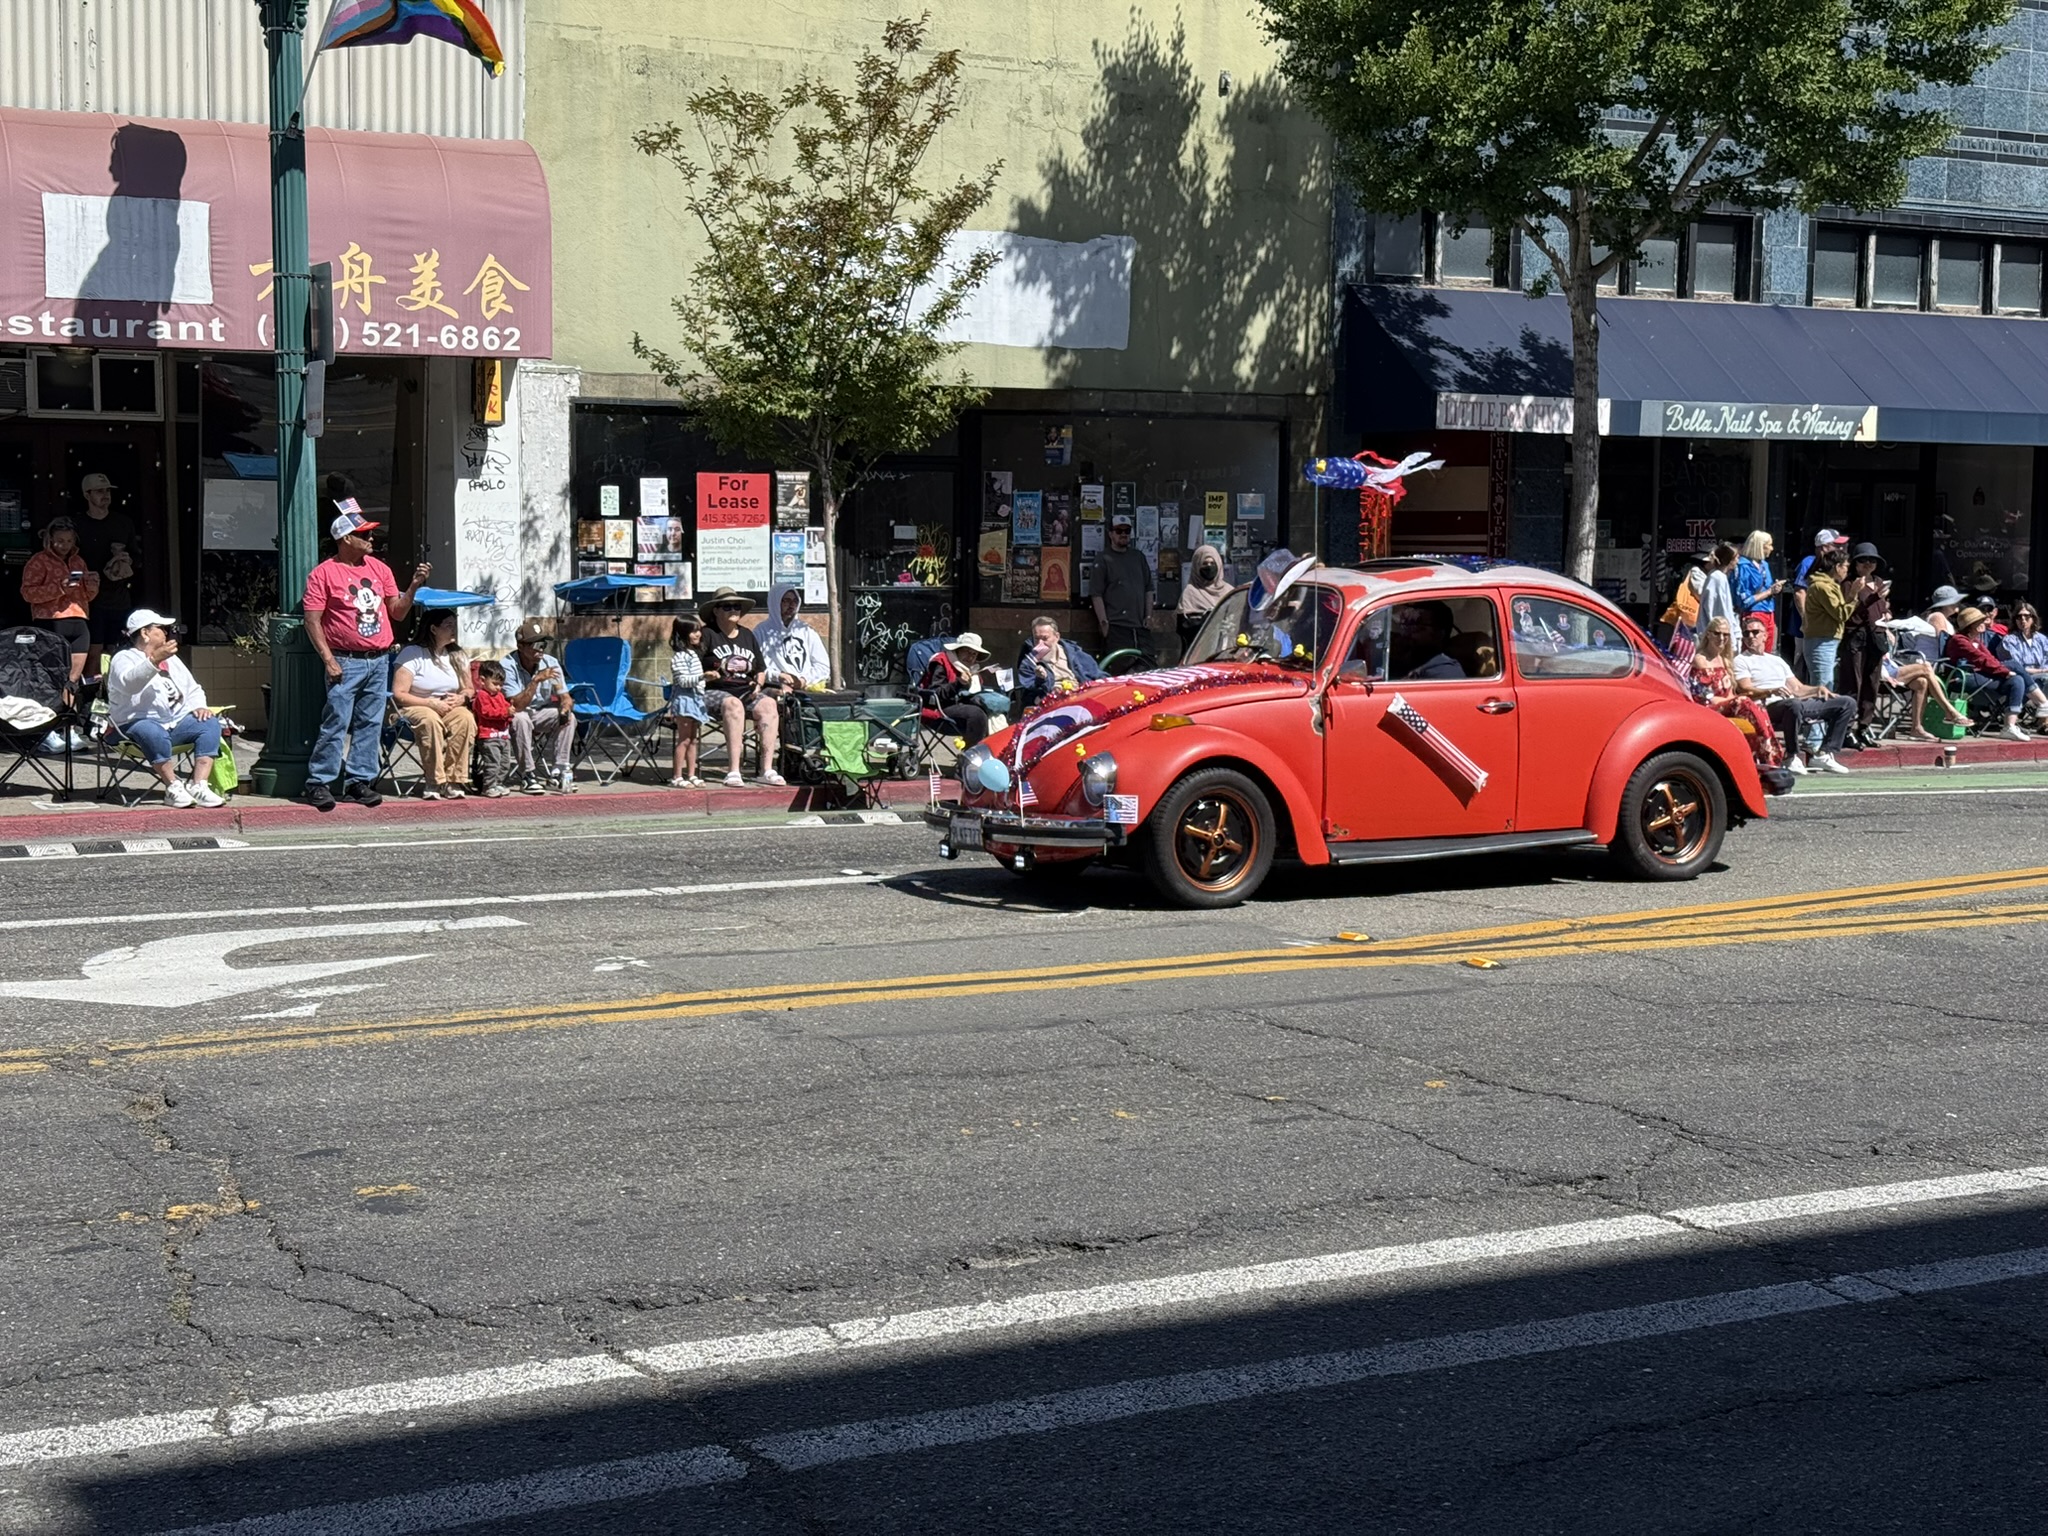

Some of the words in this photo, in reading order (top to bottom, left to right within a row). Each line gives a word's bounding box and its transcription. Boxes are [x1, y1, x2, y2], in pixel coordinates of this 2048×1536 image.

[0, 310, 226, 342] staurant
[361, 321, 521, 351] 521-6862
[1666, 404, 1713, 432] Bella
[1713, 405, 1753, 434] Nail
[1755, 411, 1783, 437] Spa
[1786, 408, 1800, 435] &
[1800, 409, 1855, 440] Waxing
[718, 476, 749, 491] For
[707, 493, 759, 509] Lease
[1208, 495, 1224, 503] IMP
[701, 513, 766, 524] 415.395.7262
[1685, 519, 1716, 537] TK
[701, 537, 725, 545] Justin
[727, 536, 746, 545] Choi
[713, 644, 732, 659] OLD
[732, 644, 755, 663] NAVY
